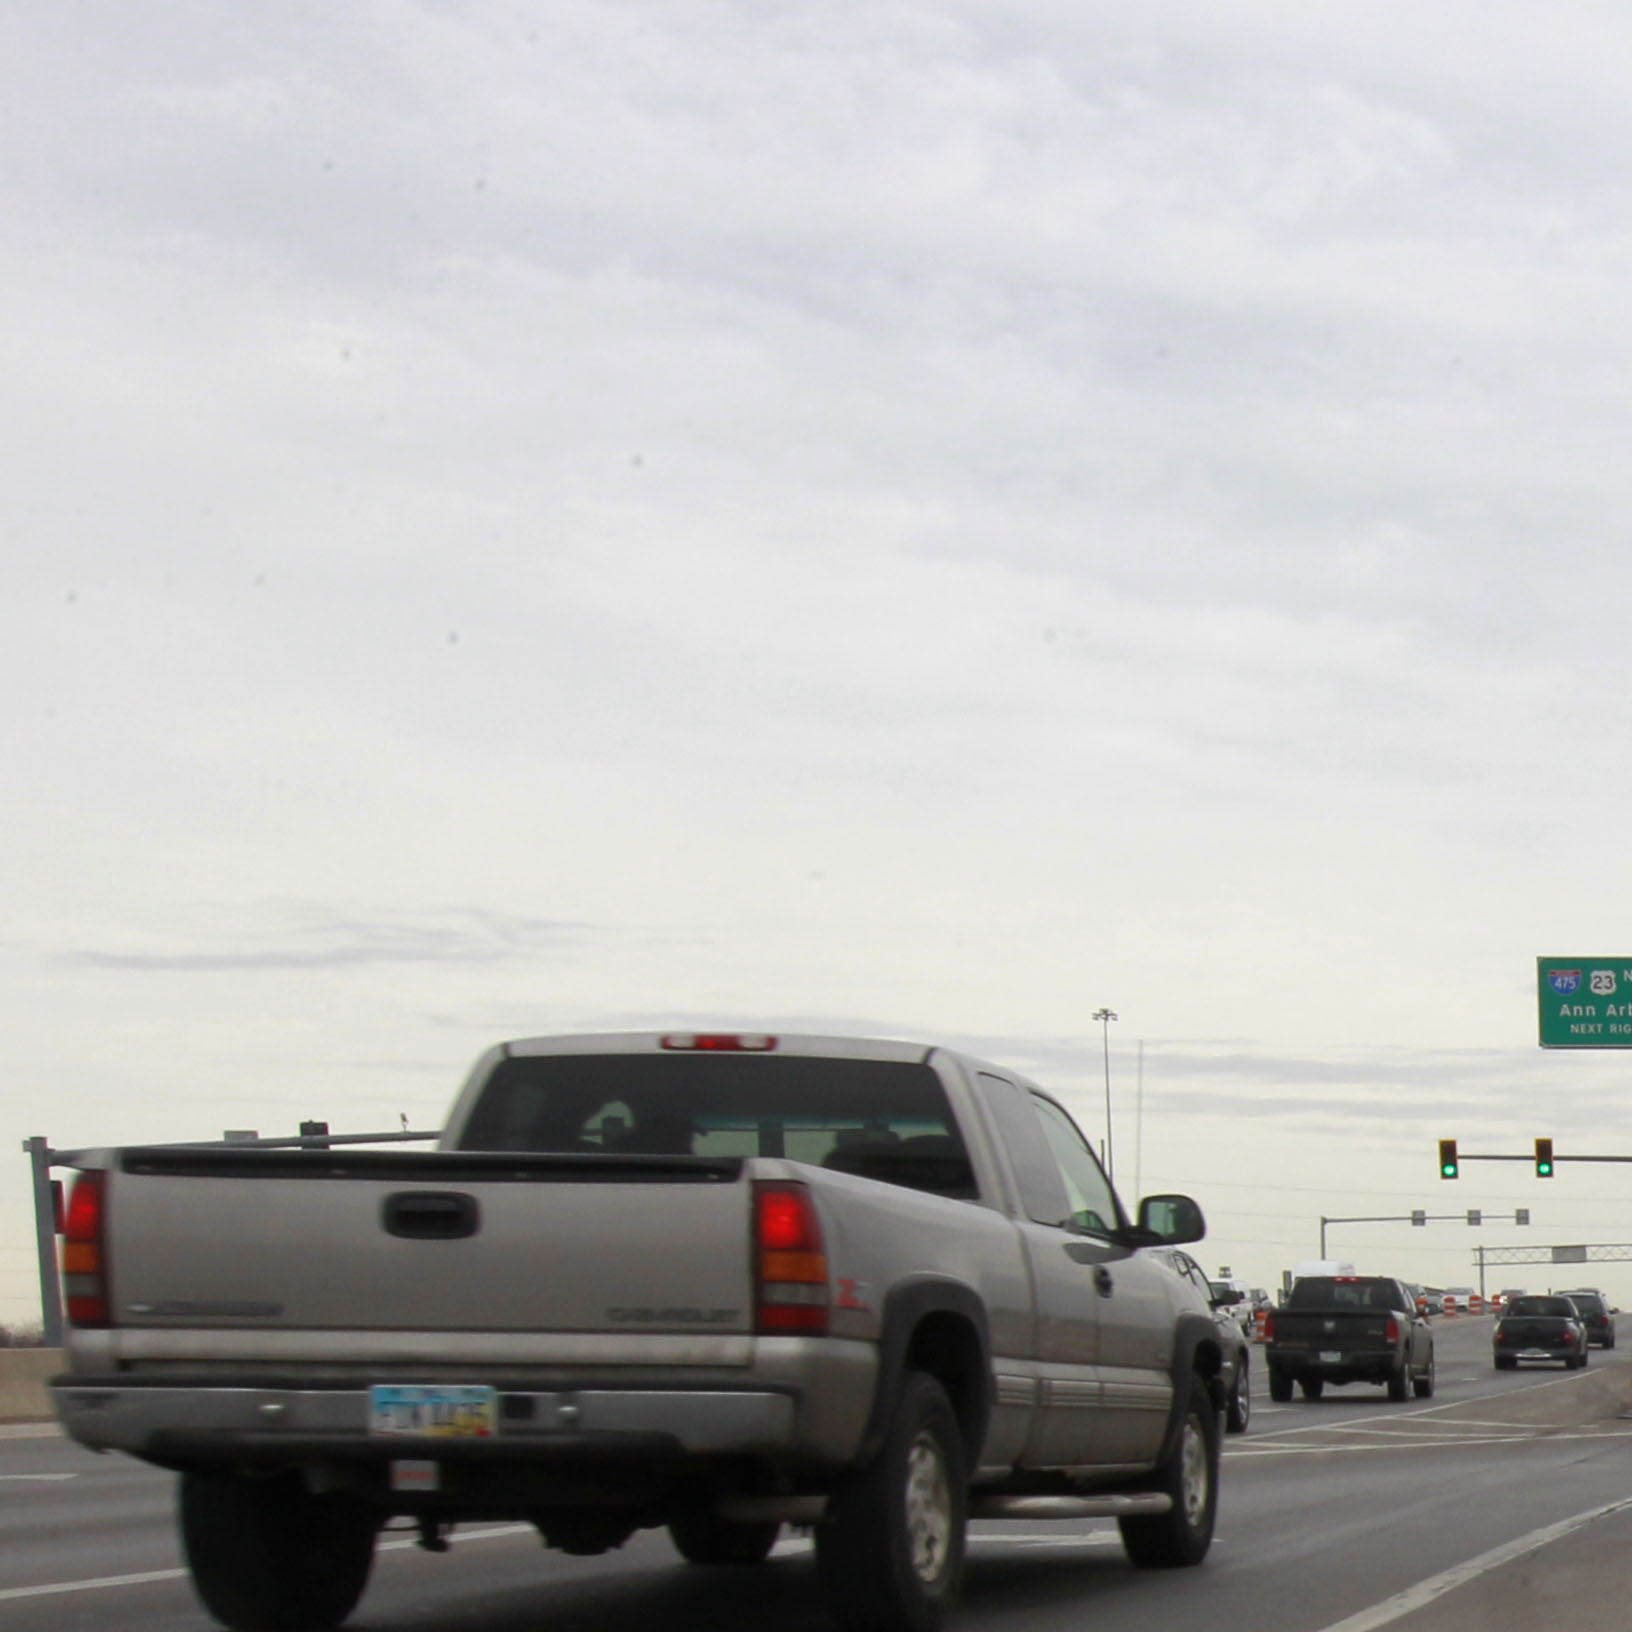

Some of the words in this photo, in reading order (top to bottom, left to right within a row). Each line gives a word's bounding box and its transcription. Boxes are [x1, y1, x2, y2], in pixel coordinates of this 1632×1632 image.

[1554, 976, 1577, 990] 475
[1592, 975, 1614, 990] 23
[1559, 1003, 1596, 1017] Ann
[1570, 1023, 1603, 1034] NEXT
